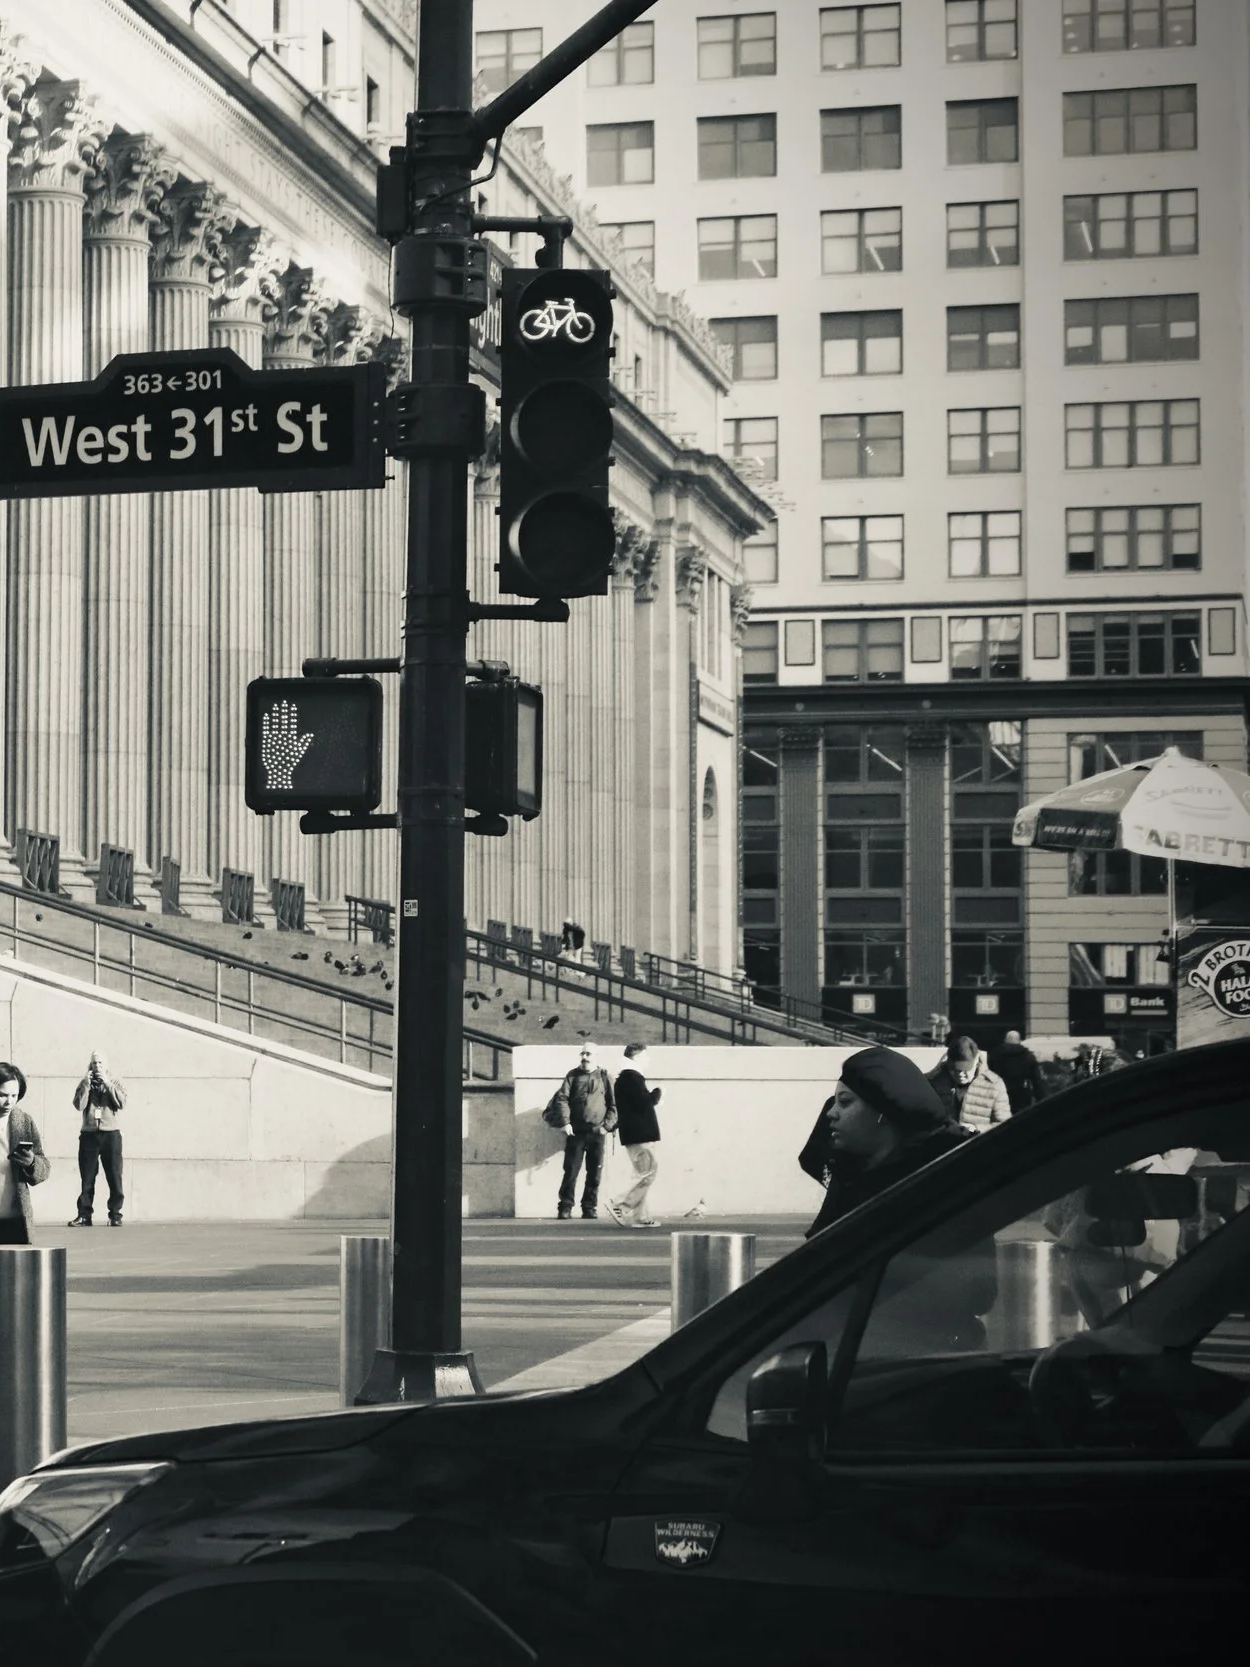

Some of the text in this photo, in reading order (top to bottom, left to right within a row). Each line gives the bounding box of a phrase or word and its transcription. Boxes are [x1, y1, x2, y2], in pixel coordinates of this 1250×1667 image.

[124, 370, 222, 395] 363 301
[21, 401, 329, 467] West 31st St
[1190, 944, 1250, 987] 2 BROT
[1221, 975, 1250, 993] HAL
[1130, 996, 1165, 1007] Bank
[656, 1528, 714, 1538] WILDERNESS
[668, 1522, 705, 1530] SUBARU
